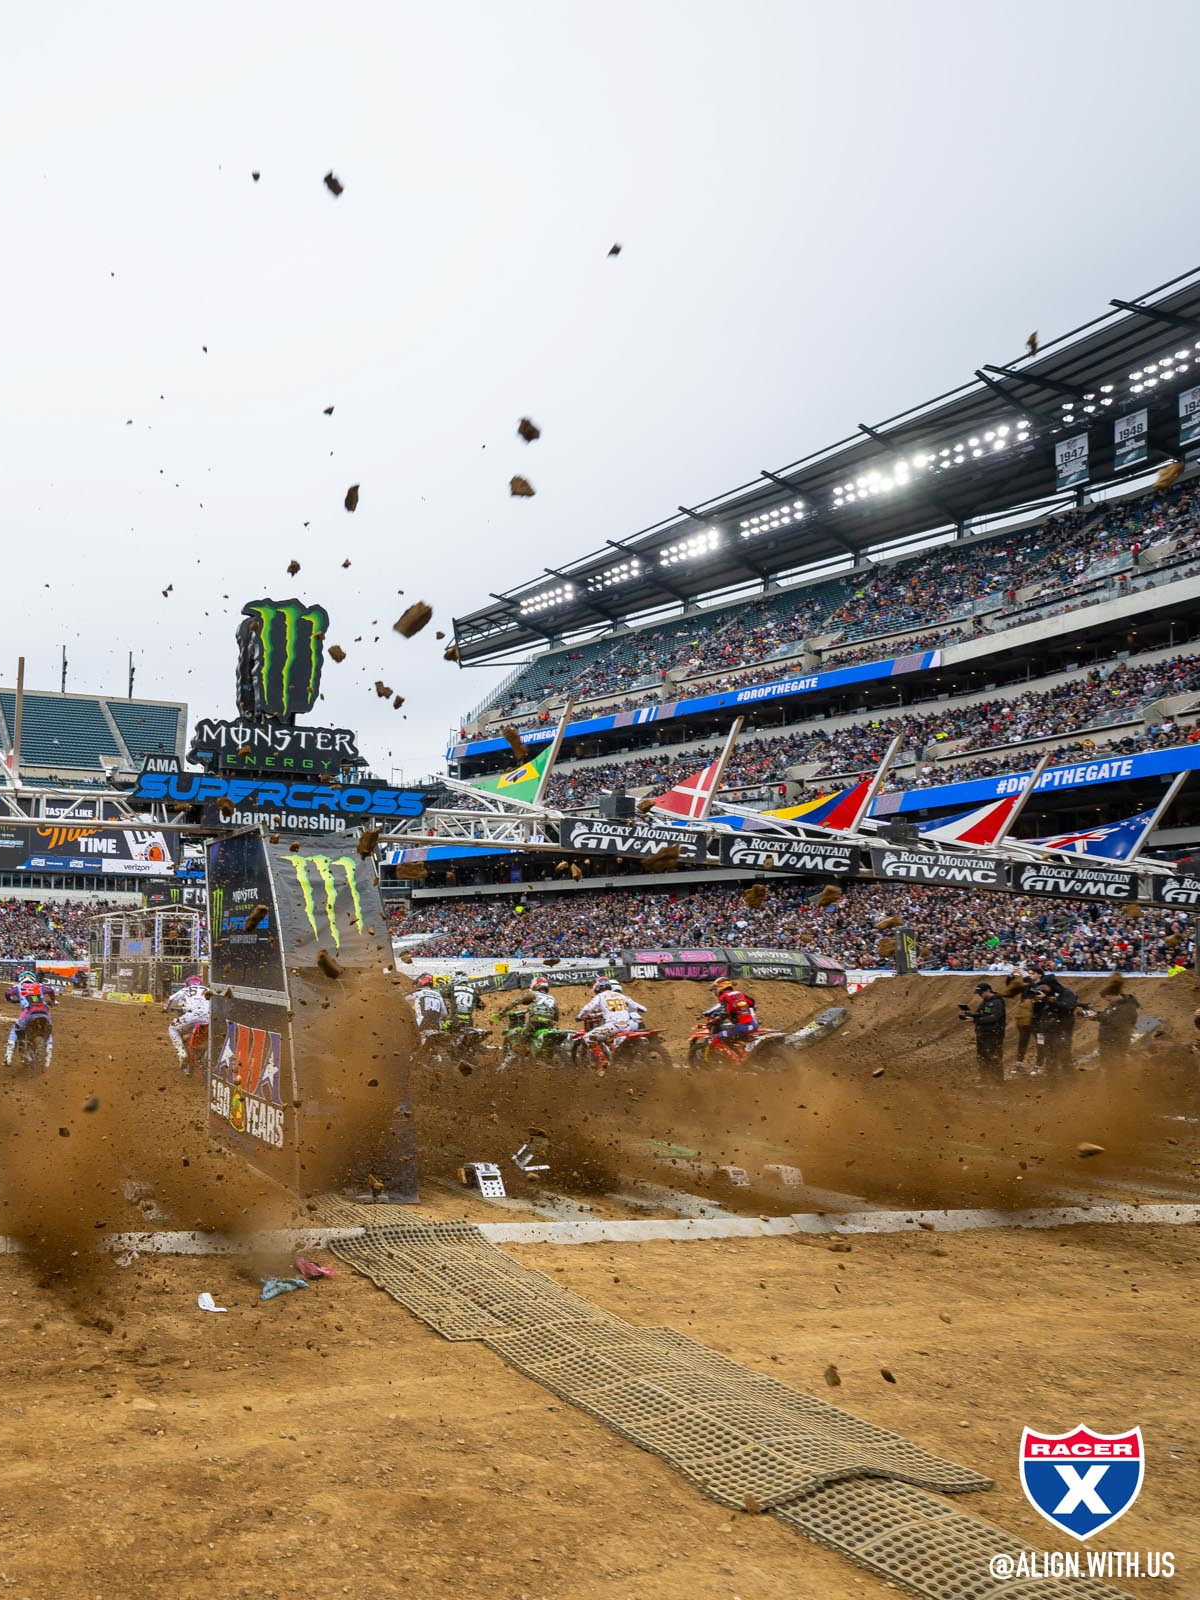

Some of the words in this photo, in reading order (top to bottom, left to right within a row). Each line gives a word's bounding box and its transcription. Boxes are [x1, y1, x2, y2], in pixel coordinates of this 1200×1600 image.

[1119, 423, 1144, 440] 1948
[1060, 446, 1085, 463] 1947
[737, 677, 818, 702] #DROPTHEGATE
[203, 724, 355, 754] MONSTER
[520, 729, 559, 744] ROPTHEGA
[146, 758, 178, 773] AMA
[226, 754, 331, 769] ENERGY
[136, 773, 427, 817] SUPERCROSS
[75, 809, 93, 817] LIKE
[219, 809, 347, 833] Championship
[591, 822, 632, 836] ROCKY
[633, 826, 698, 843] MOUNTAIN
[749, 838, 789, 851] ROCKY
[790, 841, 852, 857] MOUNTAIN
[124, 863, 150, 872] verizon
[900, 851, 936, 864] ROCKY
[937, 855, 996, 870] MOUNTAIN
[1039, 865, 1074, 879] ROCKY
[1074, 869, 1131, 883] MOUNTAIN
[547, 969, 600, 982] MONSTER
[630, 965, 659, 978] NEW!
[665, 966, 708, 977] AVAILABLE
[753, 966, 793, 975] MONSTER
[245, 1097, 284, 1148] YEARS
